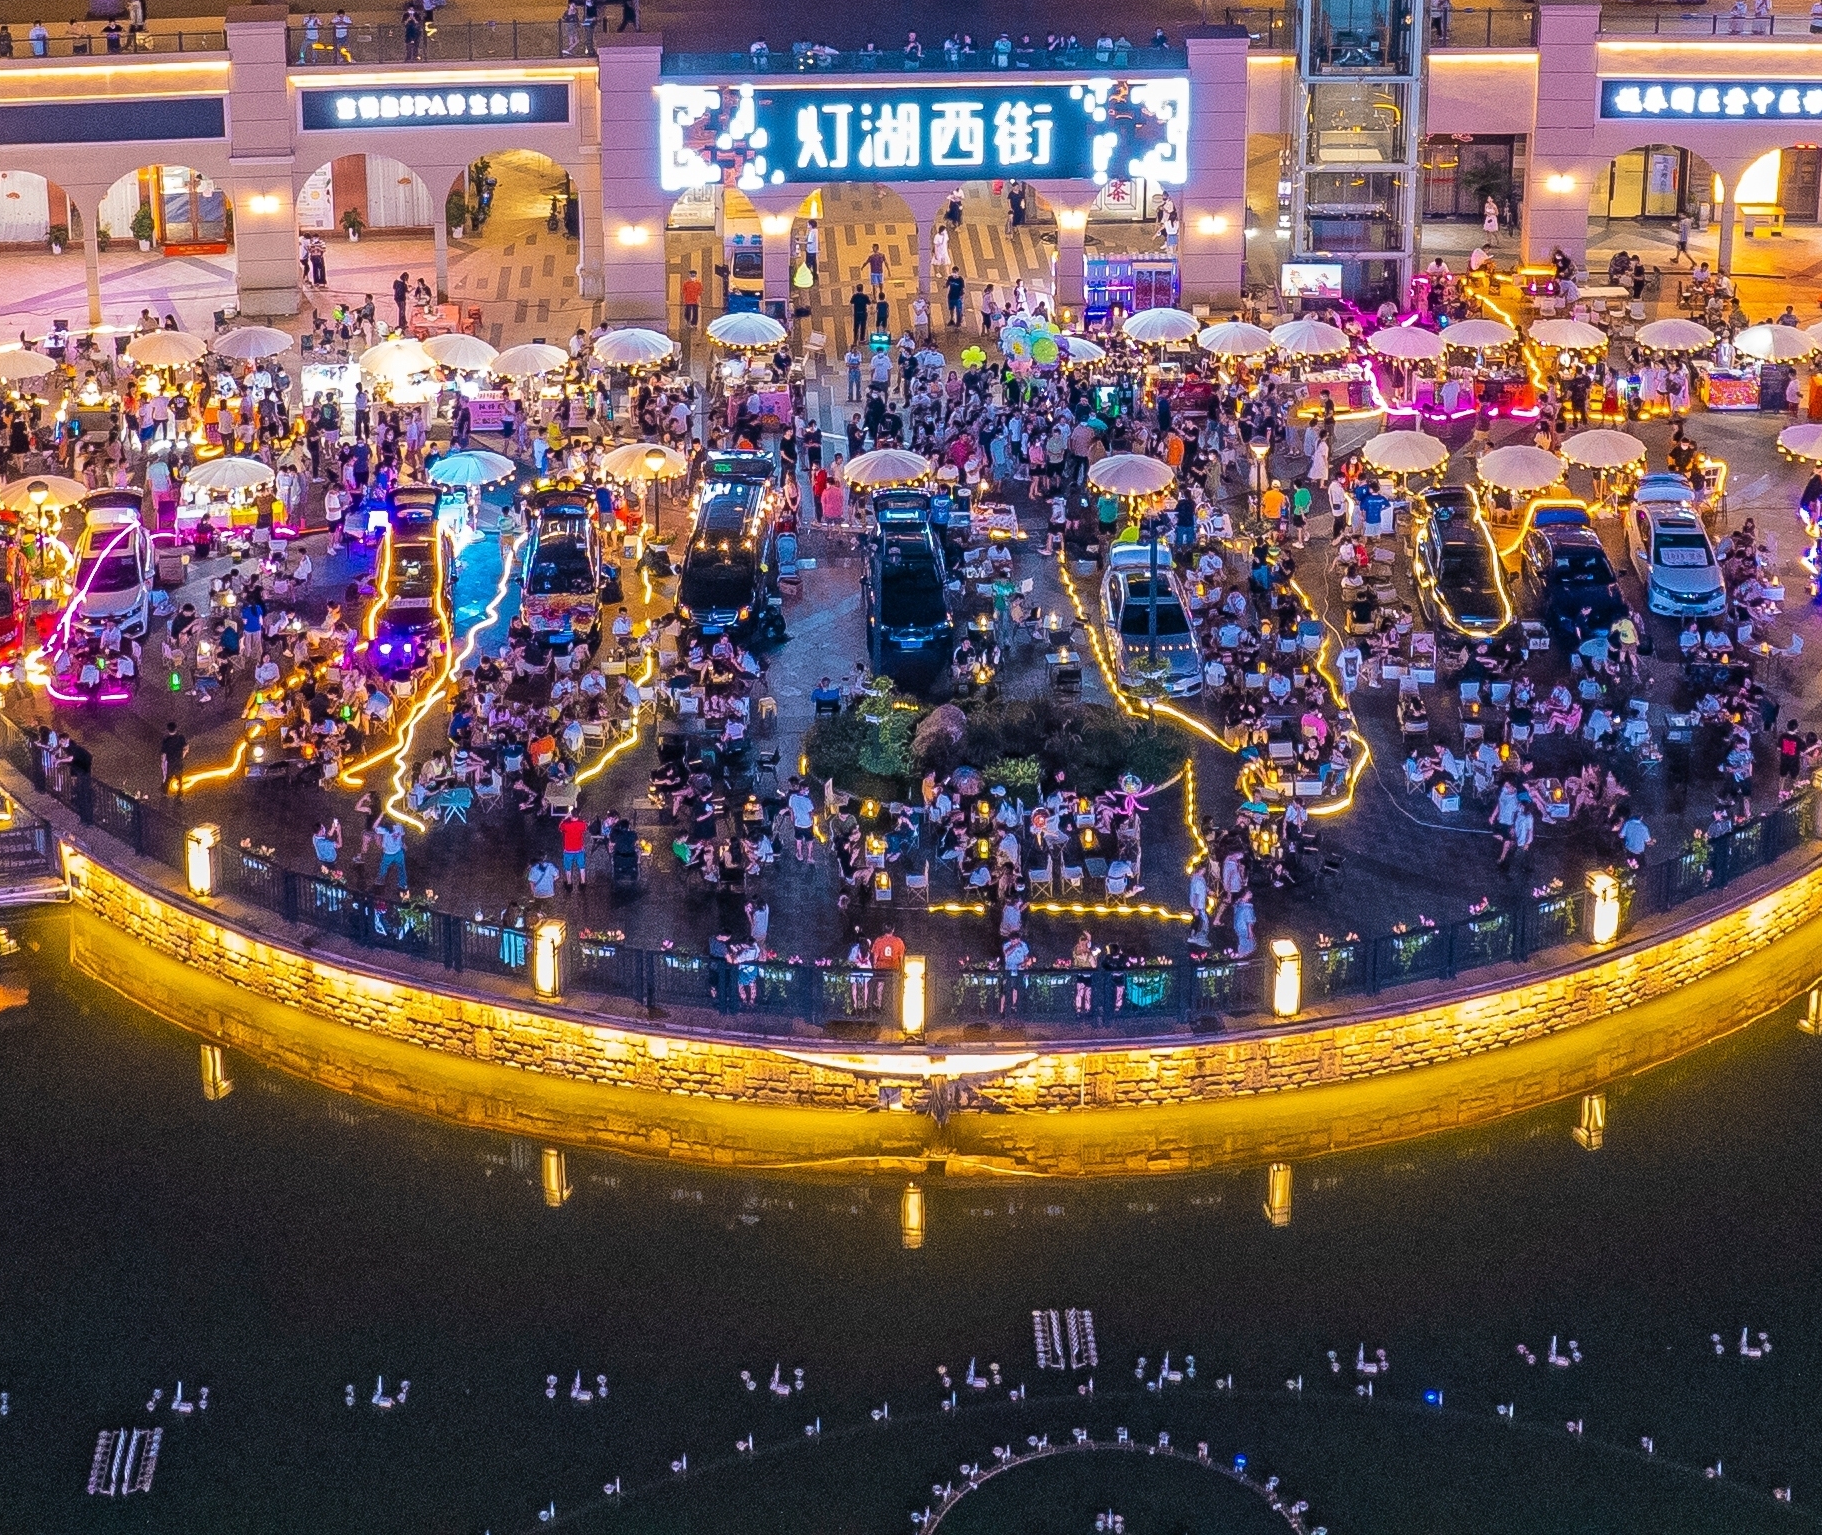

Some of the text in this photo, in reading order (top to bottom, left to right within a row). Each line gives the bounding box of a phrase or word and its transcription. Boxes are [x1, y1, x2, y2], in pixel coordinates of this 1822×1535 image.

[796, 101, 1054, 168] 灯湖西街
[1106, 179, 1130, 203] 茶
